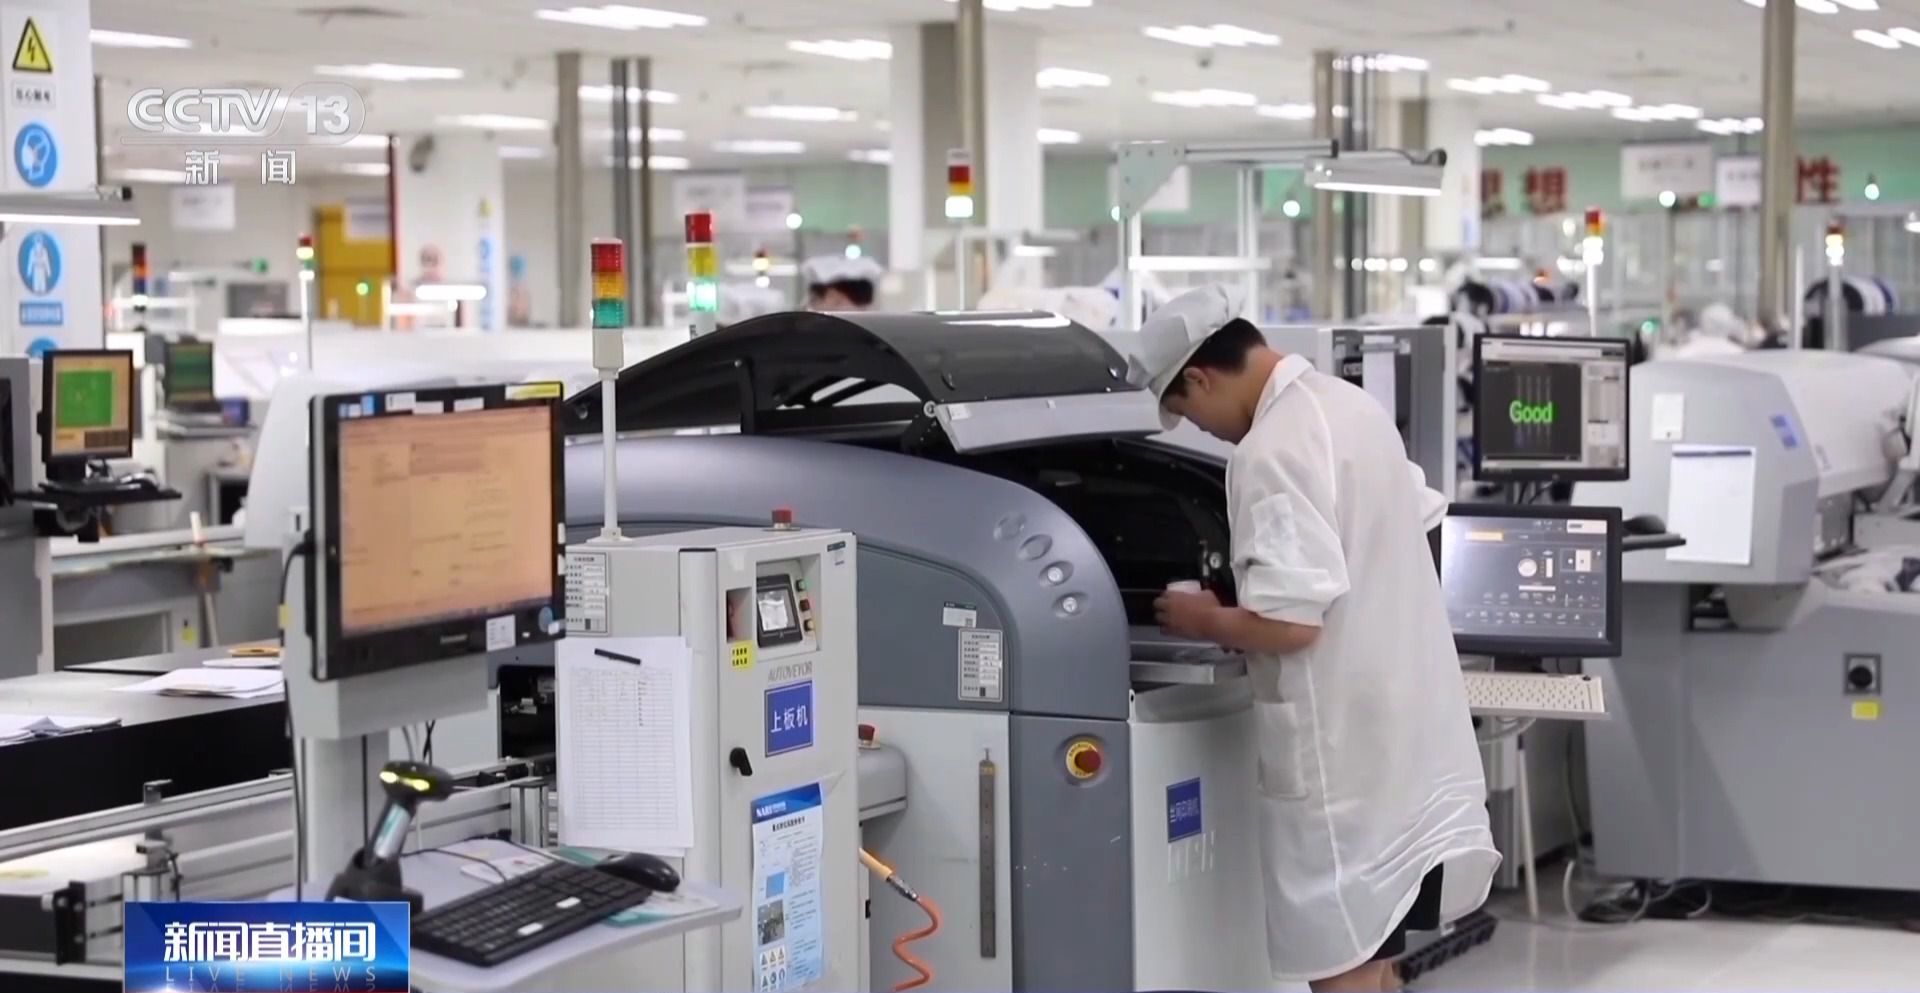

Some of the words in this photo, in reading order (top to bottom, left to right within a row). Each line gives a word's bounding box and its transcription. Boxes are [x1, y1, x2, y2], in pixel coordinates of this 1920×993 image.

[1509, 400, 1554, 425] Good
[770, 704, 809, 734] 上板机
